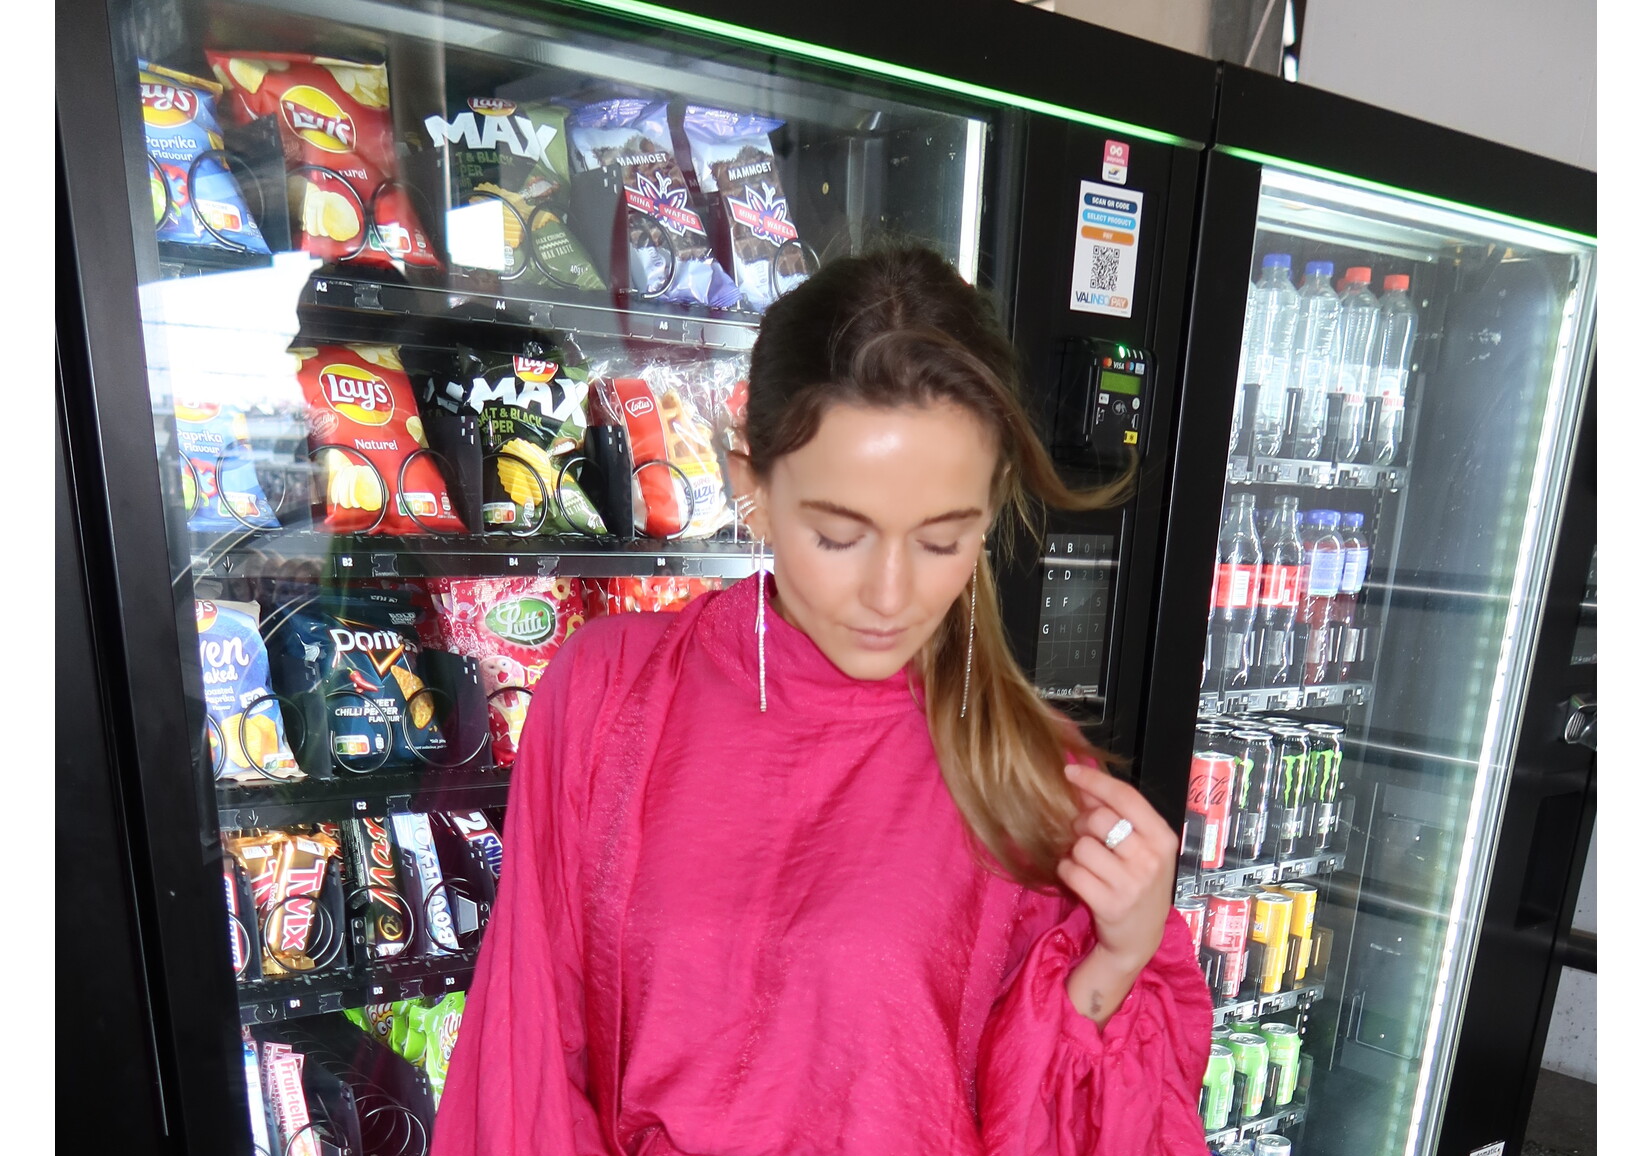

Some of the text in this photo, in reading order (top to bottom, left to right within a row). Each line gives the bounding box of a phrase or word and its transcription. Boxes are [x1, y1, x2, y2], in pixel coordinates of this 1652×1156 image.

[424, 111, 558, 174] MAX
[151, 149, 193, 161] Flavour
[617, 153, 667, 166] MAMMOET
[728, 162, 772, 181] MAMMOET
[630, 194, 696, 225] MINA WAFELS
[738, 208, 795, 237] MINA WAFELS
[1087, 212, 1132, 227] SELECT PRODUCT
[315, 282, 328, 293] A2
[495, 301, 506, 312] A4
[1113, 361, 1125, 370] VISA
[327, 374, 388, 411] Lay's
[469, 377, 589, 429] MAX
[630, 401, 651, 413] Lotus
[510, 408, 543, 429] BLACK
[183, 442, 220, 455] Flavour
[354, 438, 399, 451] Naturel
[1049, 542, 1056, 553] A
[1067, 542, 1074, 553] B
[341, 557, 354, 567] B2
[508, 557, 519, 567] B4
[1047, 569, 1054, 581] C
[1064, 569, 1072, 581] D
[1045, 597, 1051, 608] E
[1062, 597, 1069, 608] F
[496, 604, 551, 637] Lutti
[1042, 623, 1050, 635] G
[1060, 624, 1067, 634] H
[1074, 649, 1097, 660] 8 9
[335, 707, 362, 717] CHILLI
[356, 801, 367, 811] C2
[280, 859, 326, 951] TWIX
[445, 977, 455, 986] D3
[373, 986, 384, 995] D2
[290, 999, 301, 1009] D1
